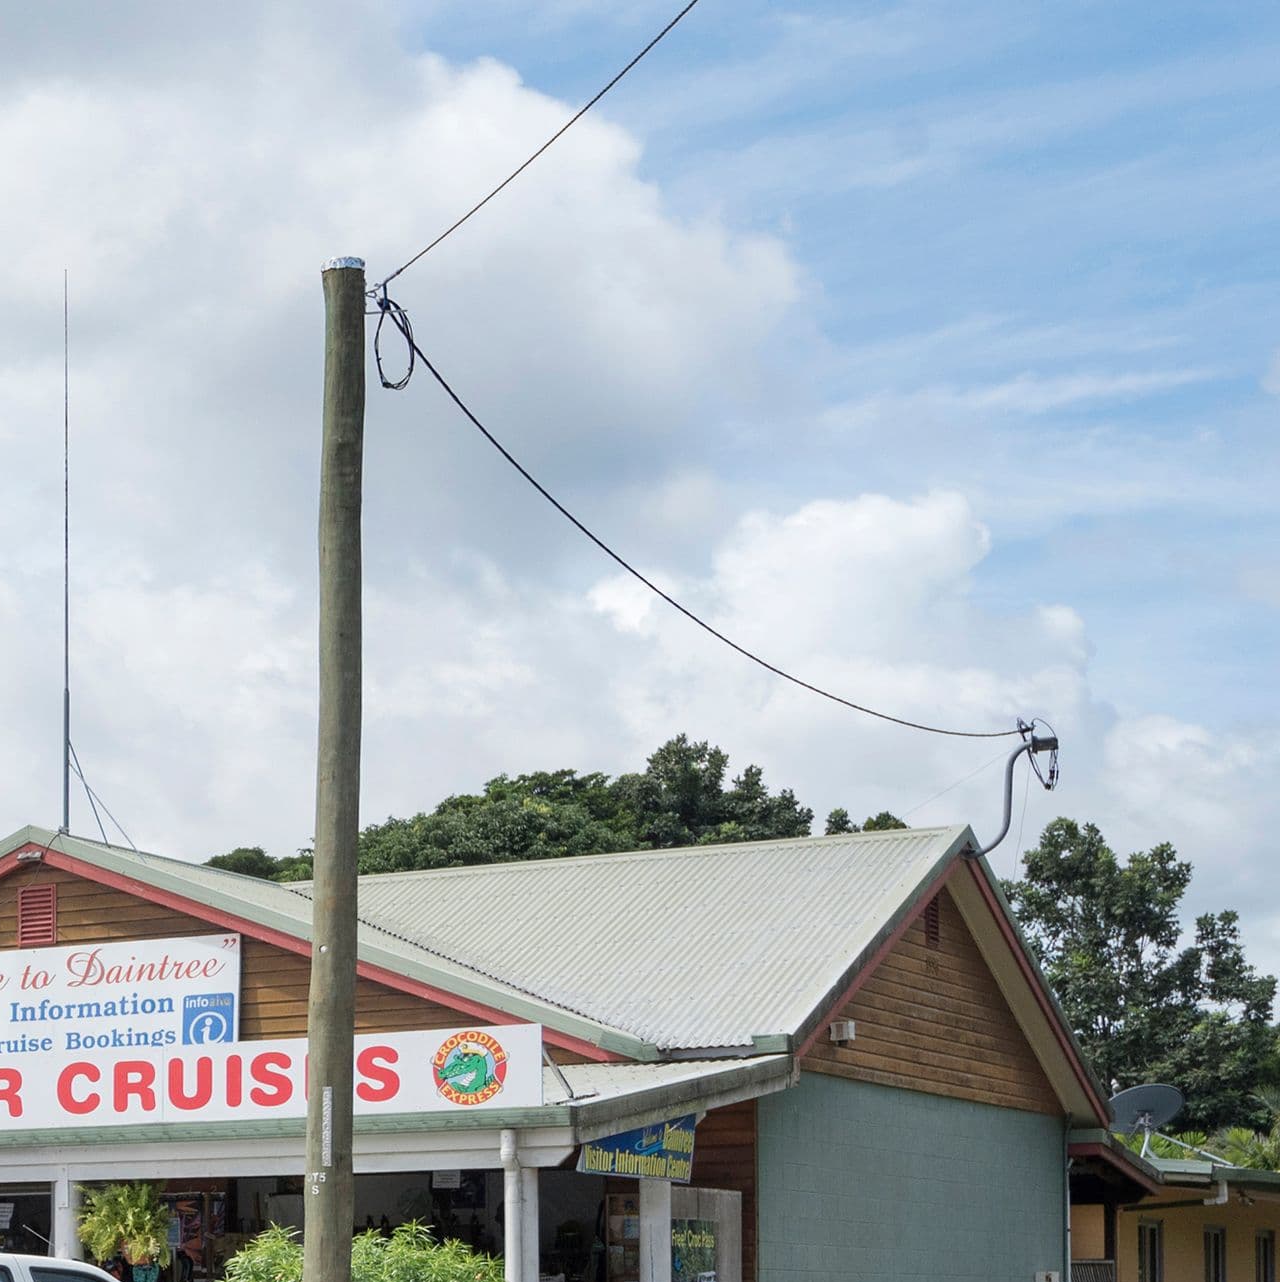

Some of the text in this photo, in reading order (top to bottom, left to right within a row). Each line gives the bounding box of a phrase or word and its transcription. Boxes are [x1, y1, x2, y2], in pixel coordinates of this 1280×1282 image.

[20, 965, 56, 990] to
[10, 992, 174, 1022] Information
[65, 1028, 177, 1050] Bookings
[435, 1031, 506, 1065] CROCODILE
[57, 1045, 400, 1115] CRUISS
[441, 1081, 500, 1105] EXPRESS
[584, 1144, 614, 1172] Visitor
[615, 1148, 667, 1177] Information
